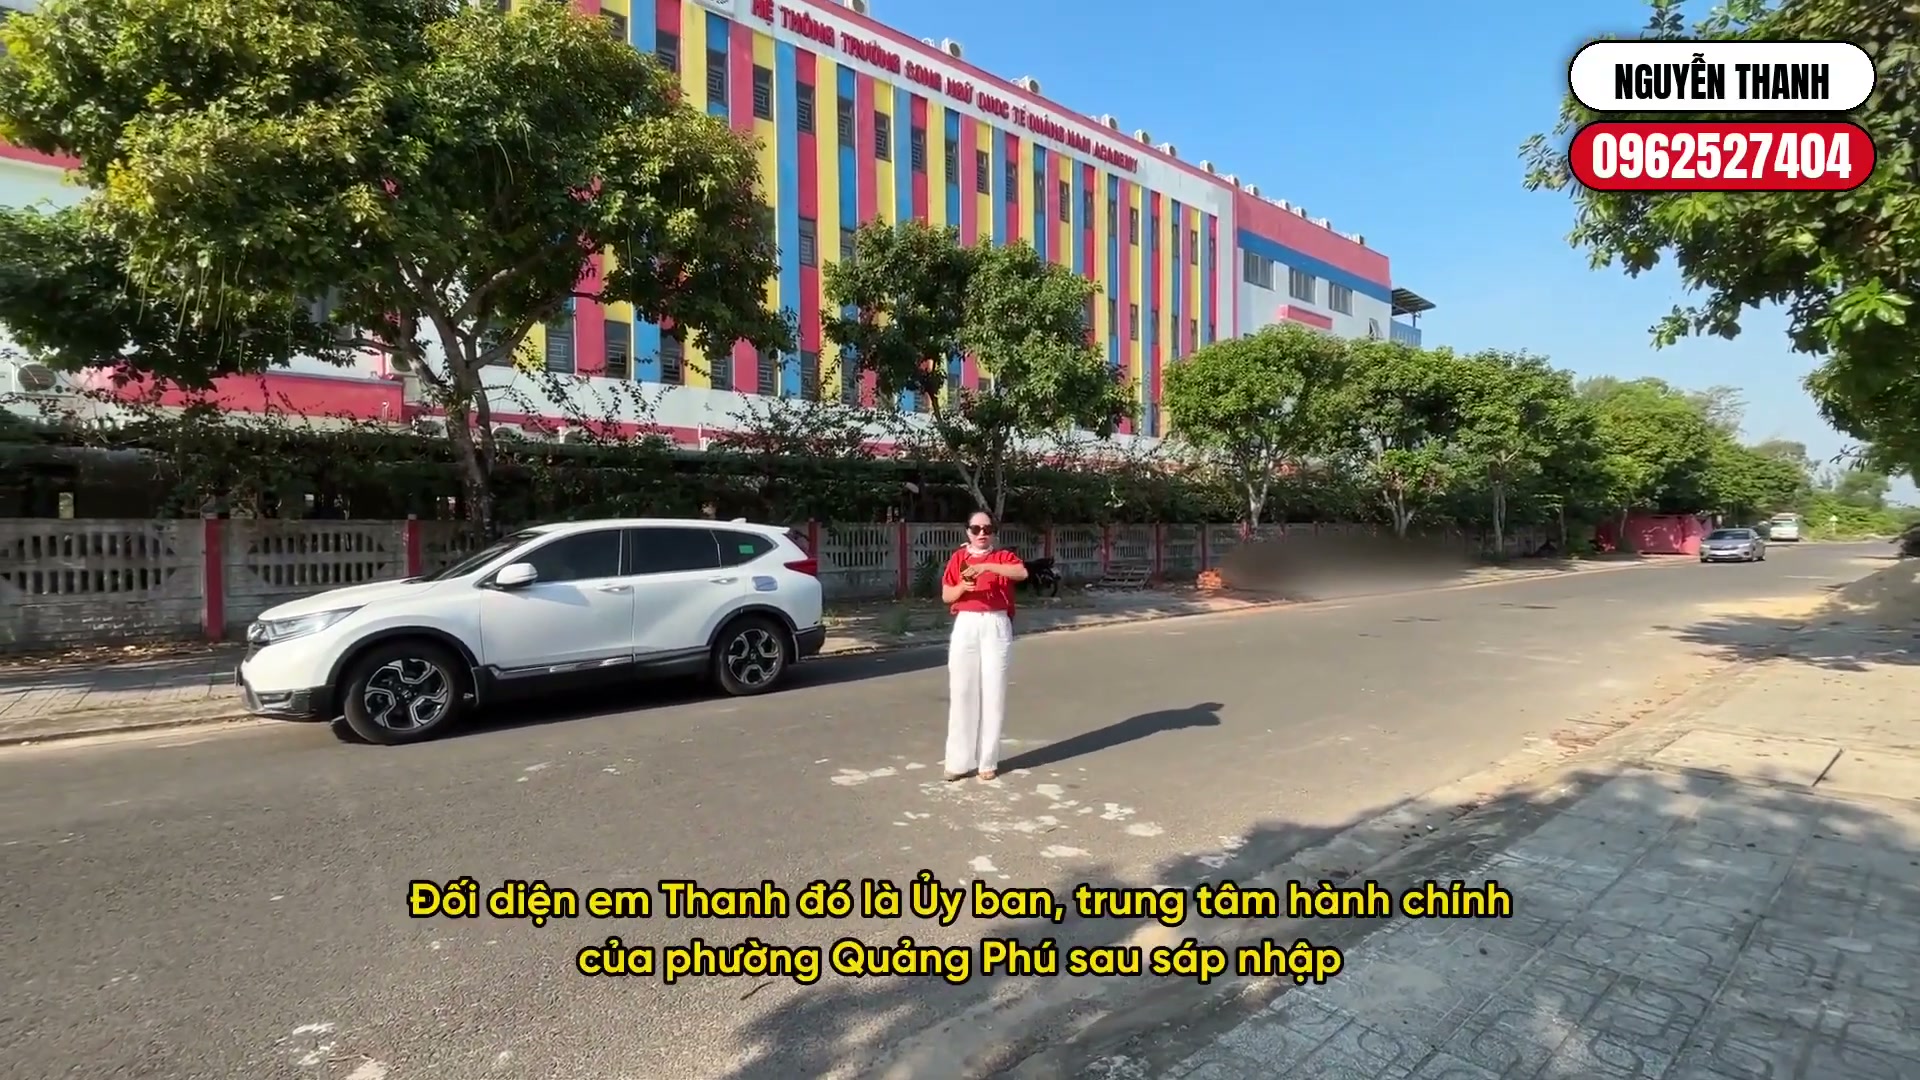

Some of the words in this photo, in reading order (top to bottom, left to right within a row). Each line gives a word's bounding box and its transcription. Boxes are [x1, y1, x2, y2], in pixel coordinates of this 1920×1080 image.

[905, 59, 943, 93] SONG
[1065, 128, 1091, 155] NAM
[1092, 141, 1139, 174] ACADEMY
